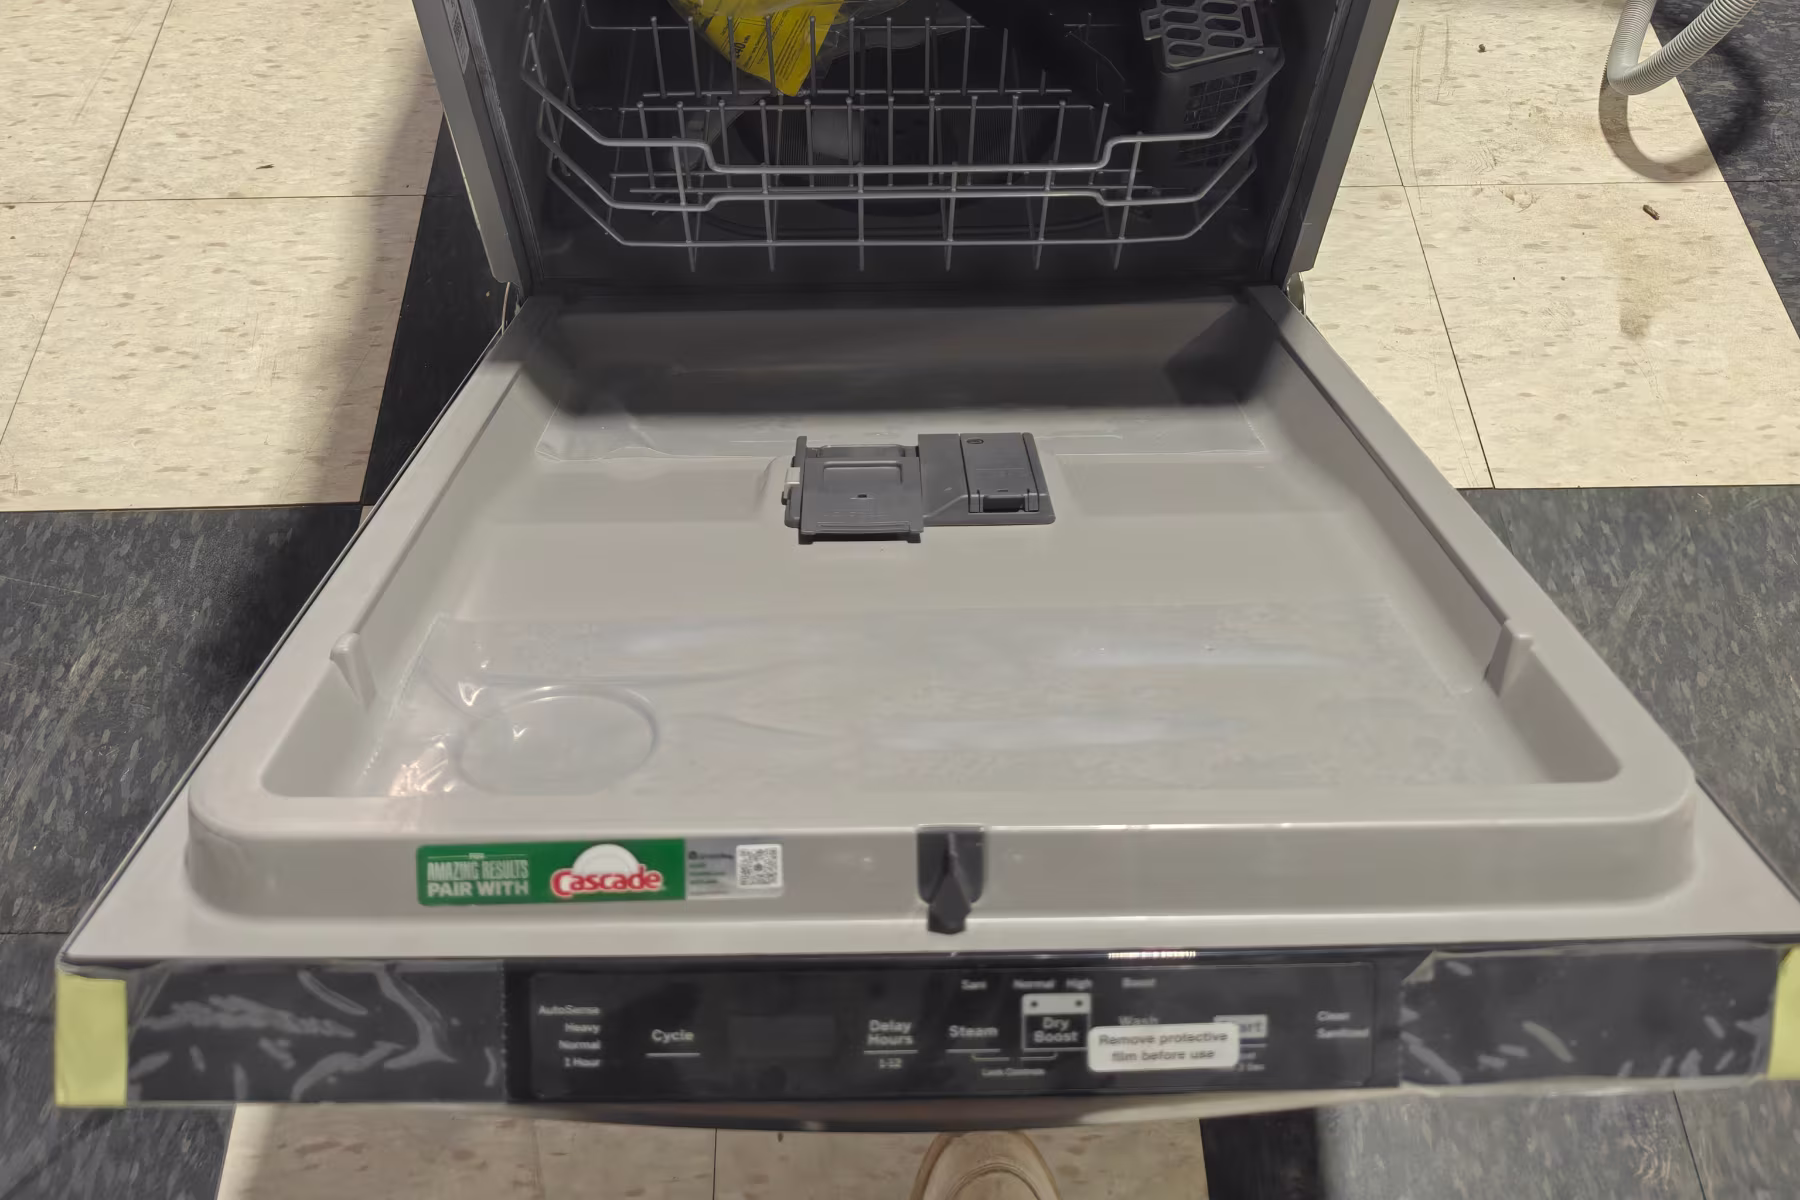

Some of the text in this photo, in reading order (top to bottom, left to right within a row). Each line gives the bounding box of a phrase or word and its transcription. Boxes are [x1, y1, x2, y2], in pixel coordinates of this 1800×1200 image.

[427, 859, 529, 881] AMAZING RESULTS
[427, 880, 529, 897] PAIR WITH
[551, 864, 664, 898] Cascade
[868, 1019, 912, 1034] Delay
[1043, 1016, 1070, 1031] Dry
[651, 1028, 695, 1044] Cycle
[949, 1024, 999, 1039] Steam
[1033, 1031, 1079, 1044] Boost
[1098, 1031, 1229, 1047] Remove protective
[867, 1033, 914, 1046] Hours
[1111, 1049, 1216, 1062] film before use
